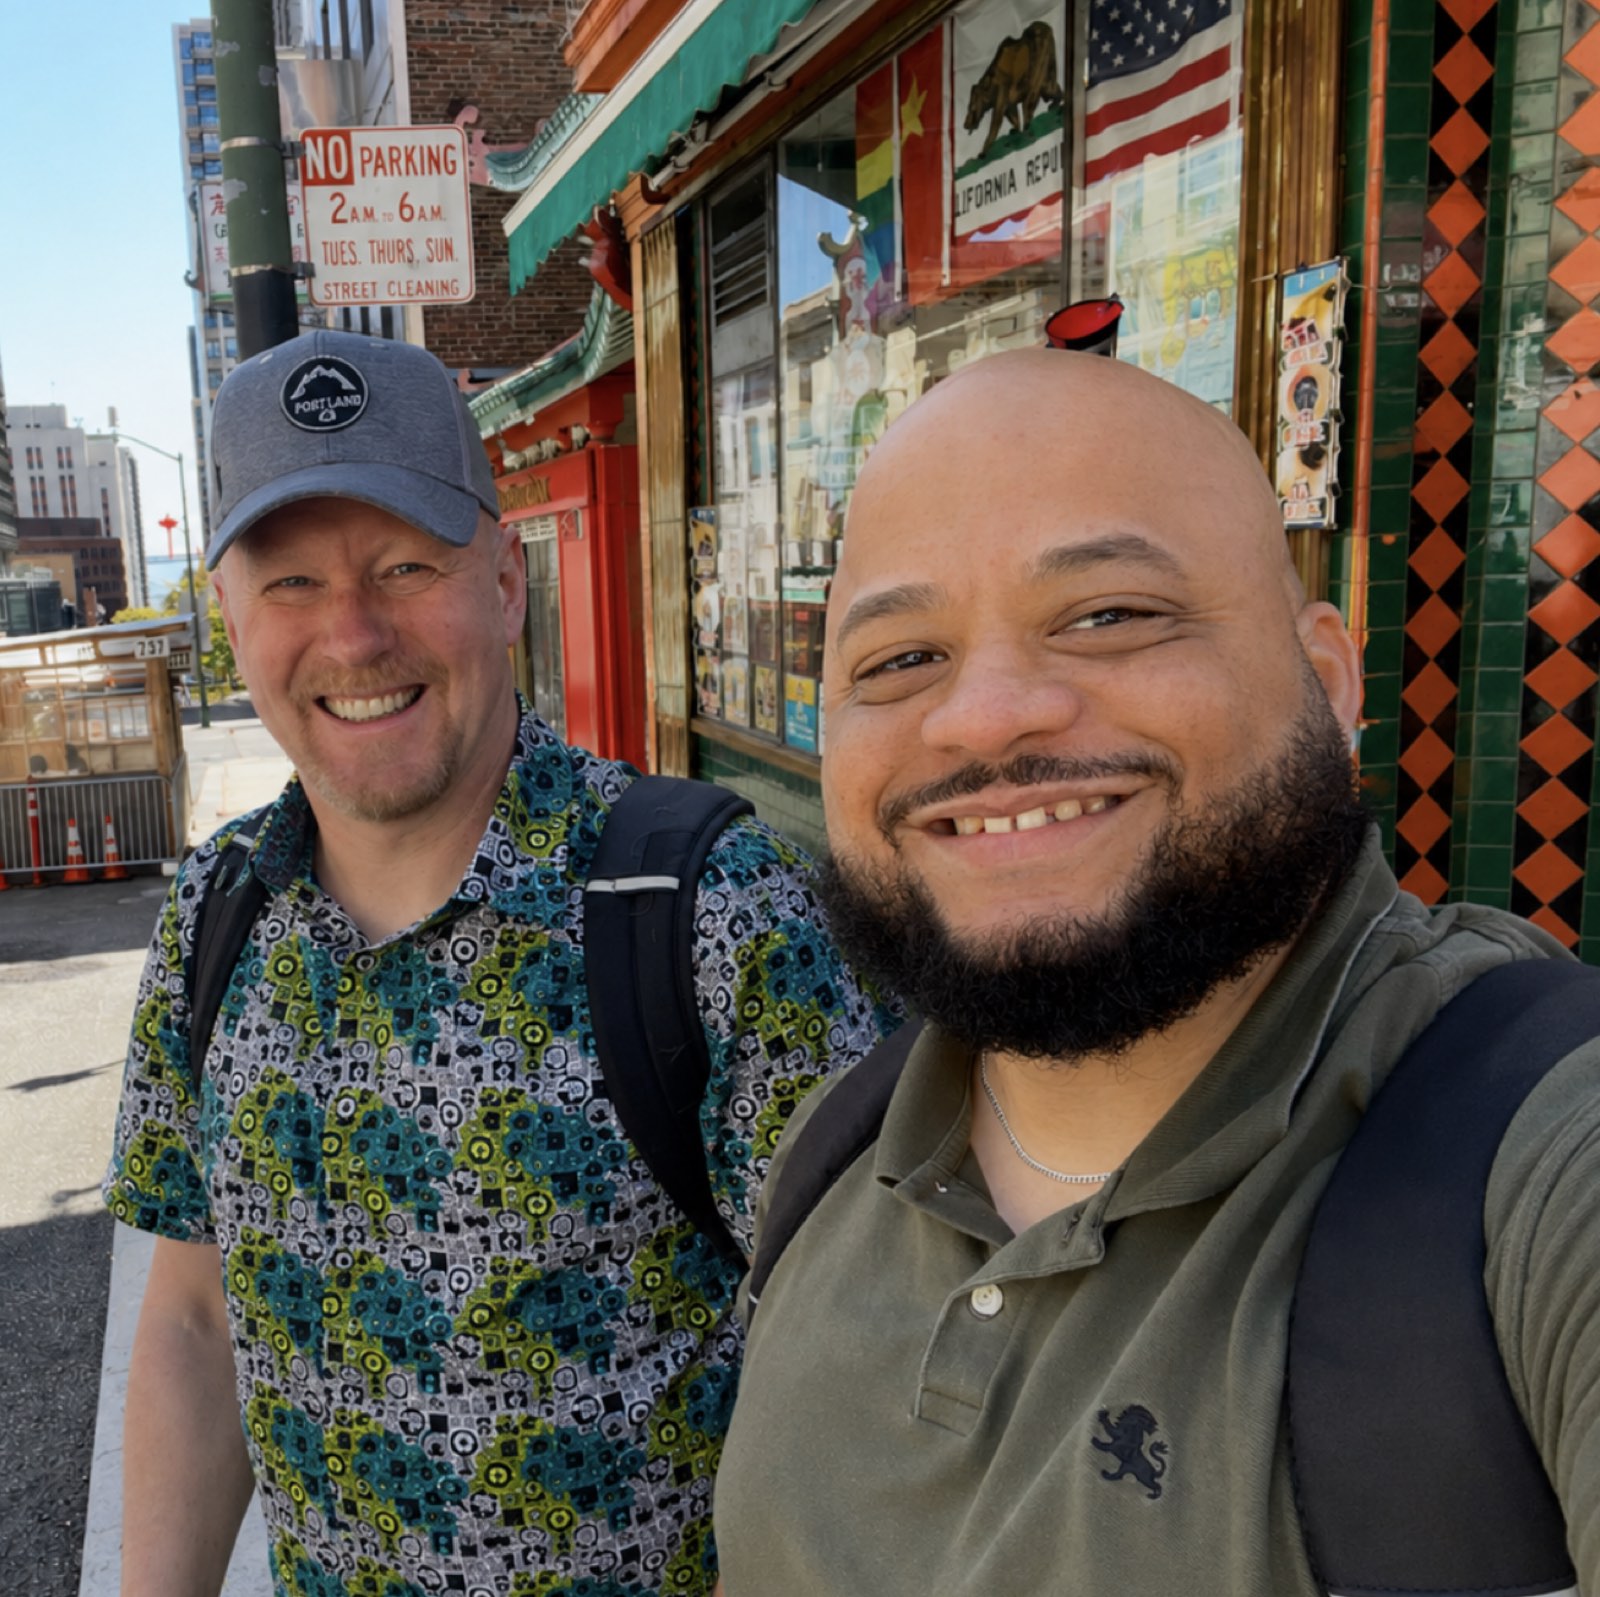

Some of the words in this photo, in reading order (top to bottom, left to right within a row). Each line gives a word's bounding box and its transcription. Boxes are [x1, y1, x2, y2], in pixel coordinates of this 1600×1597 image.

[304, 135, 349, 180] NO
[360, 144, 457, 178] PARKING
[1027, 144, 1063, 187] REPU
[322, 240, 362, 266] TUES.
[426, 236, 459, 264] SUN.
[325, 282, 378, 300] STREET
[387, 279, 459, 298] CLEANING
[295, 395, 361, 415] PORTLAND
